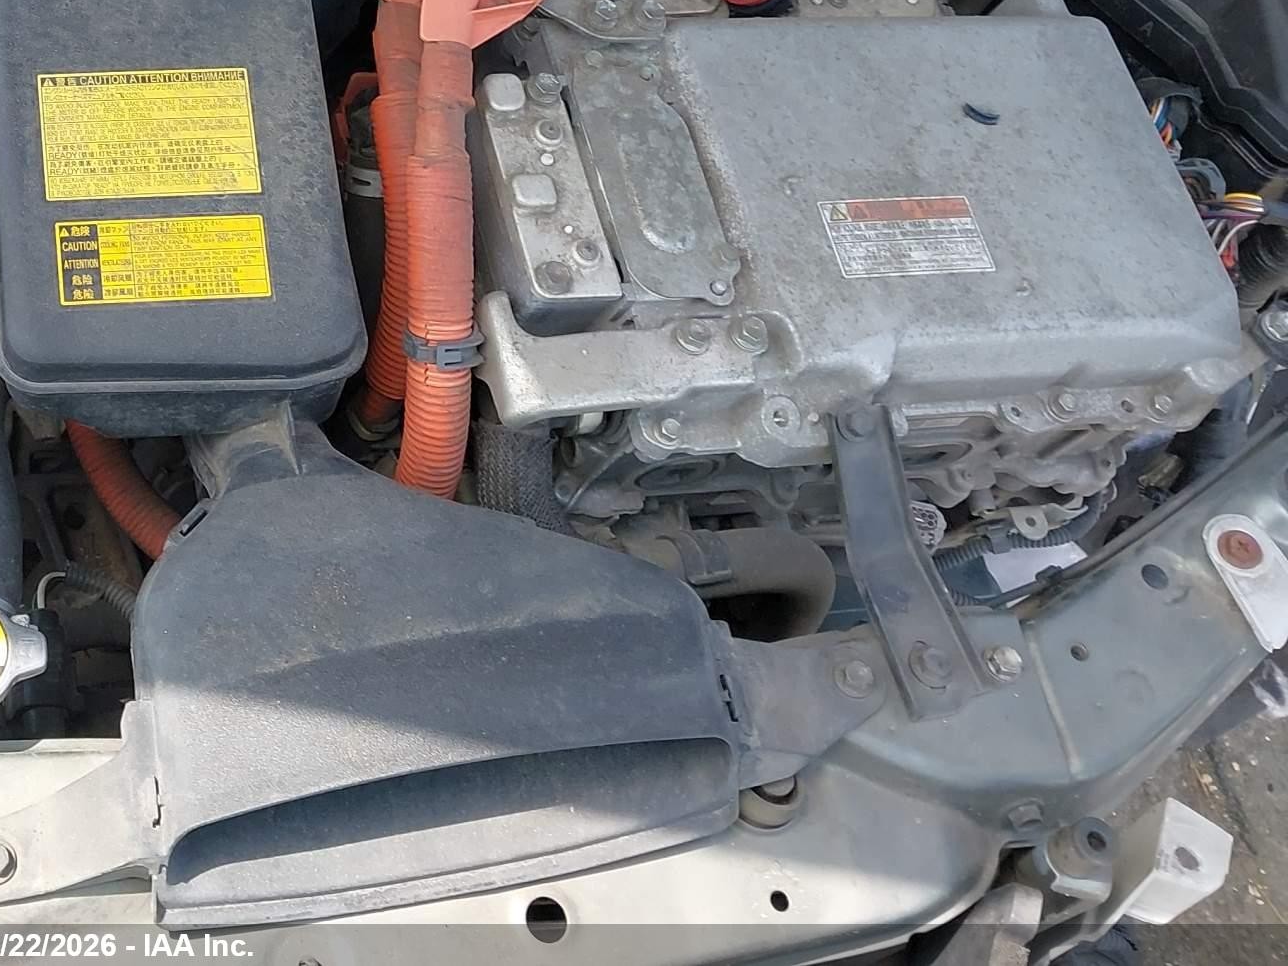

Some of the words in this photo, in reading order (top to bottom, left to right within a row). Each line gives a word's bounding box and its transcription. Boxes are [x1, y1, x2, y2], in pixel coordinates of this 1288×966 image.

[79, 75, 127, 85] CAUTION
[129, 73, 189, 83] ATTENTION
[191, 71, 244, 82] ВНИМАНИЕ
[61, 240, 97, 252] CAUTION
[63, 258, 98, 269] ATTENTION
